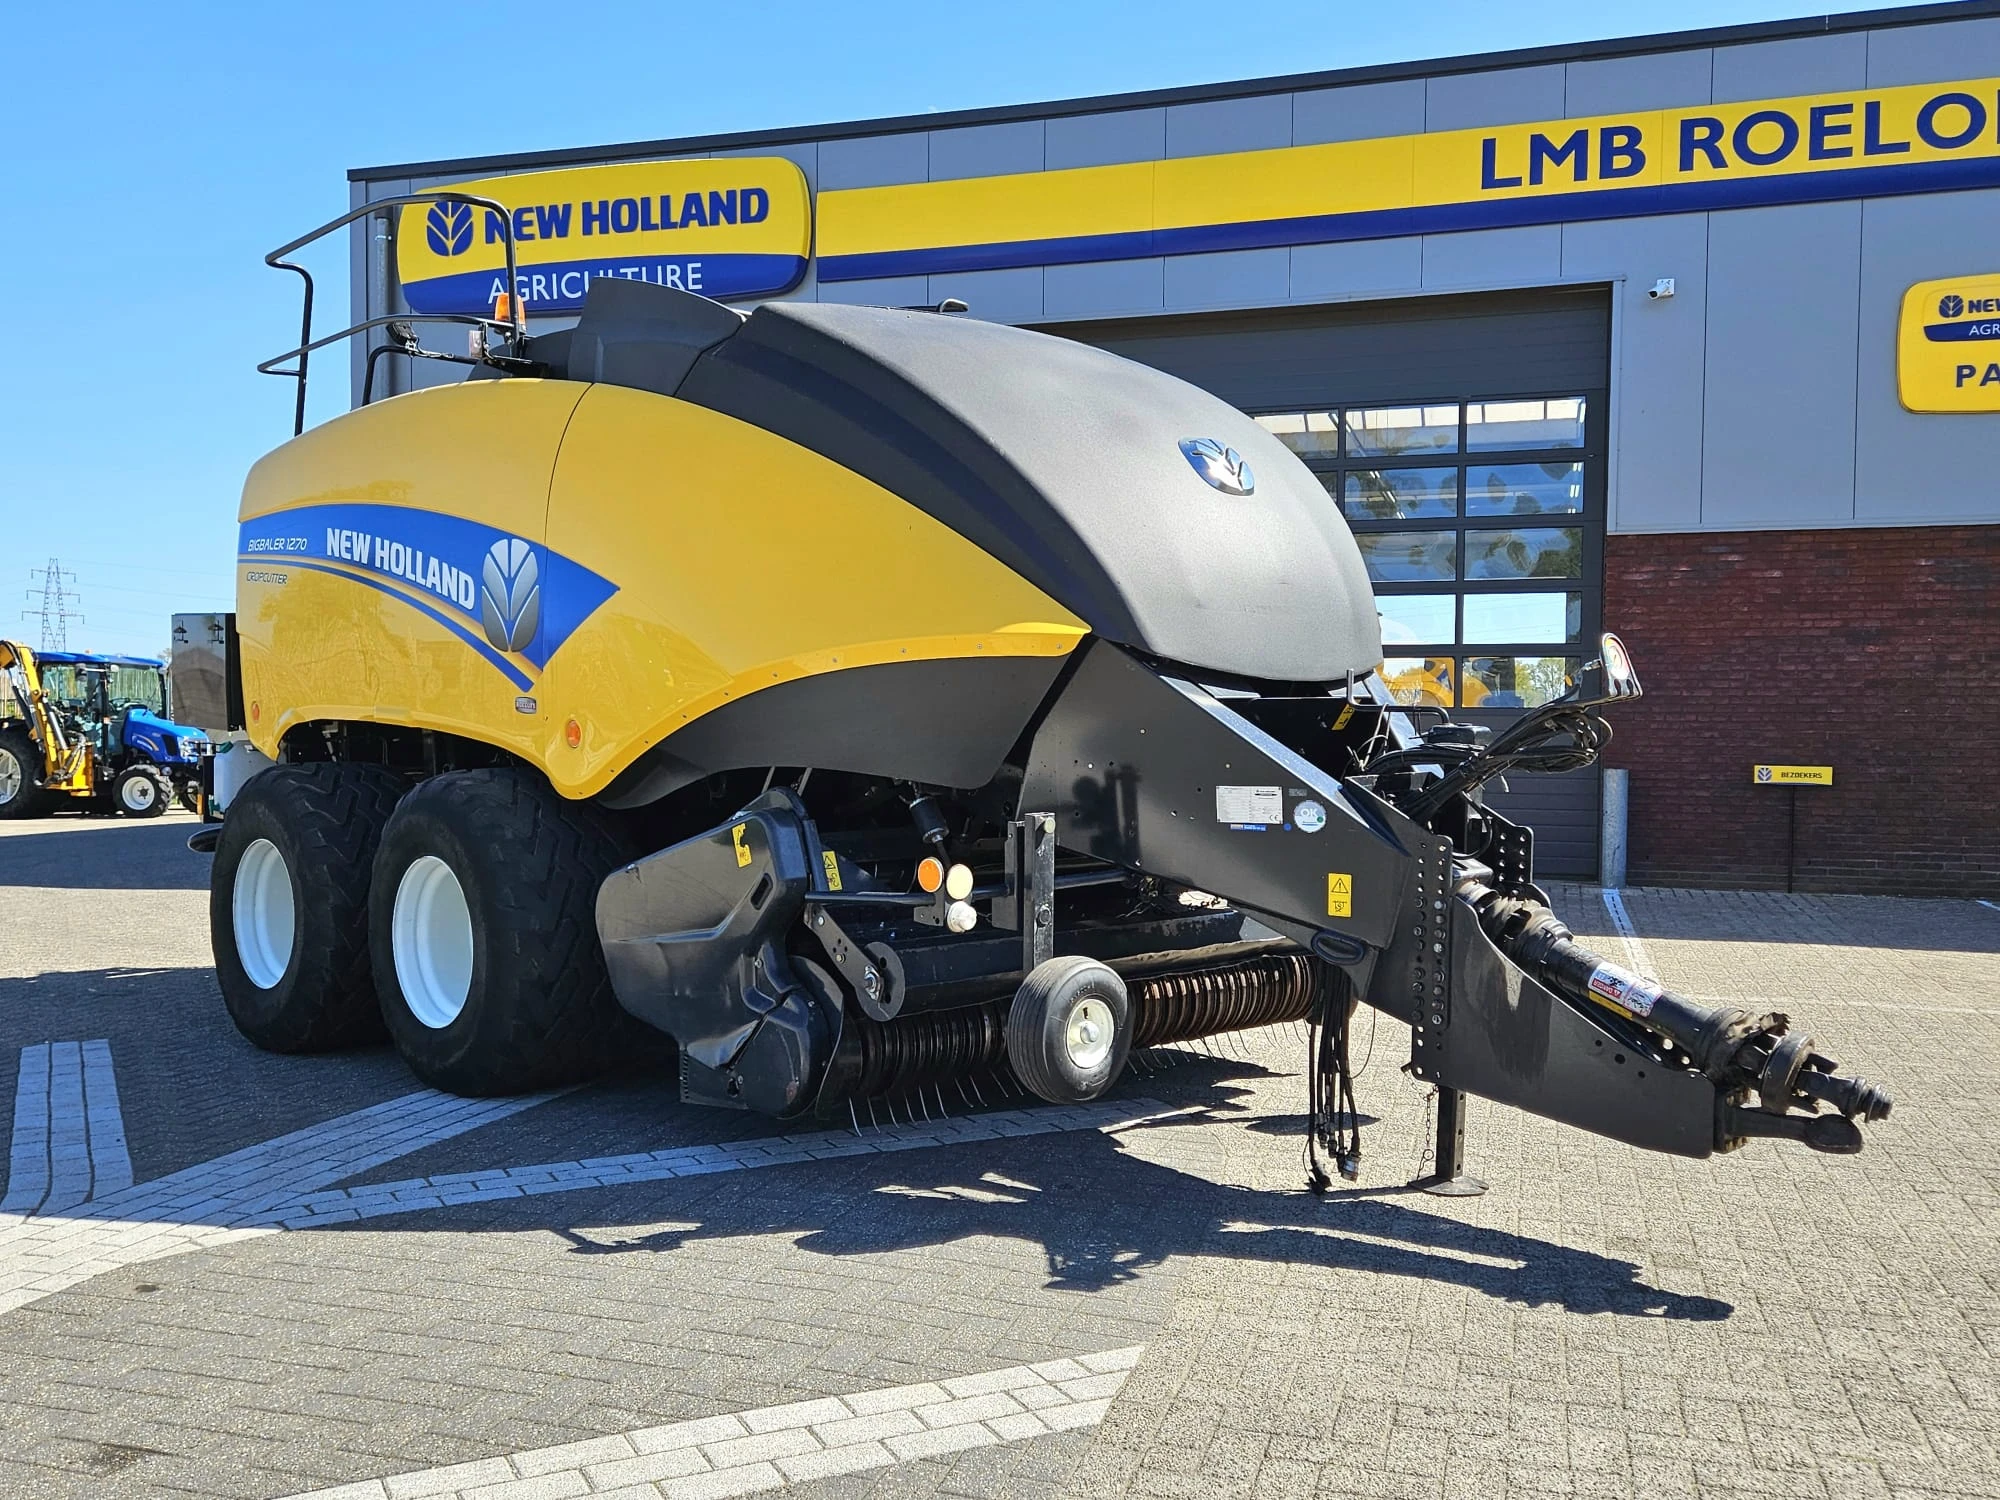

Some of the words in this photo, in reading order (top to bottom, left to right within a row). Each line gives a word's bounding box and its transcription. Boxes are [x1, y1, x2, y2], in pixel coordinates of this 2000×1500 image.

[1481, 125, 1646, 189] LMB
[1679, 91, 2000, 172] ROELO
[485, 203, 571, 244] NEW
[582, 187, 769, 236] HOLLAND
[488, 262, 703, 304] AGRICTURE
[1956, 363, 2000, 388] PA
[248, 538, 285, 552] BIGBALER
[286, 538, 308, 550] 1270
[247, 571, 288, 584] CROPCUTTER
[326, 527, 371, 565] NEW
[375, 536, 475, 610] HOLLAND
[1300, 808, 1317, 817] OK
